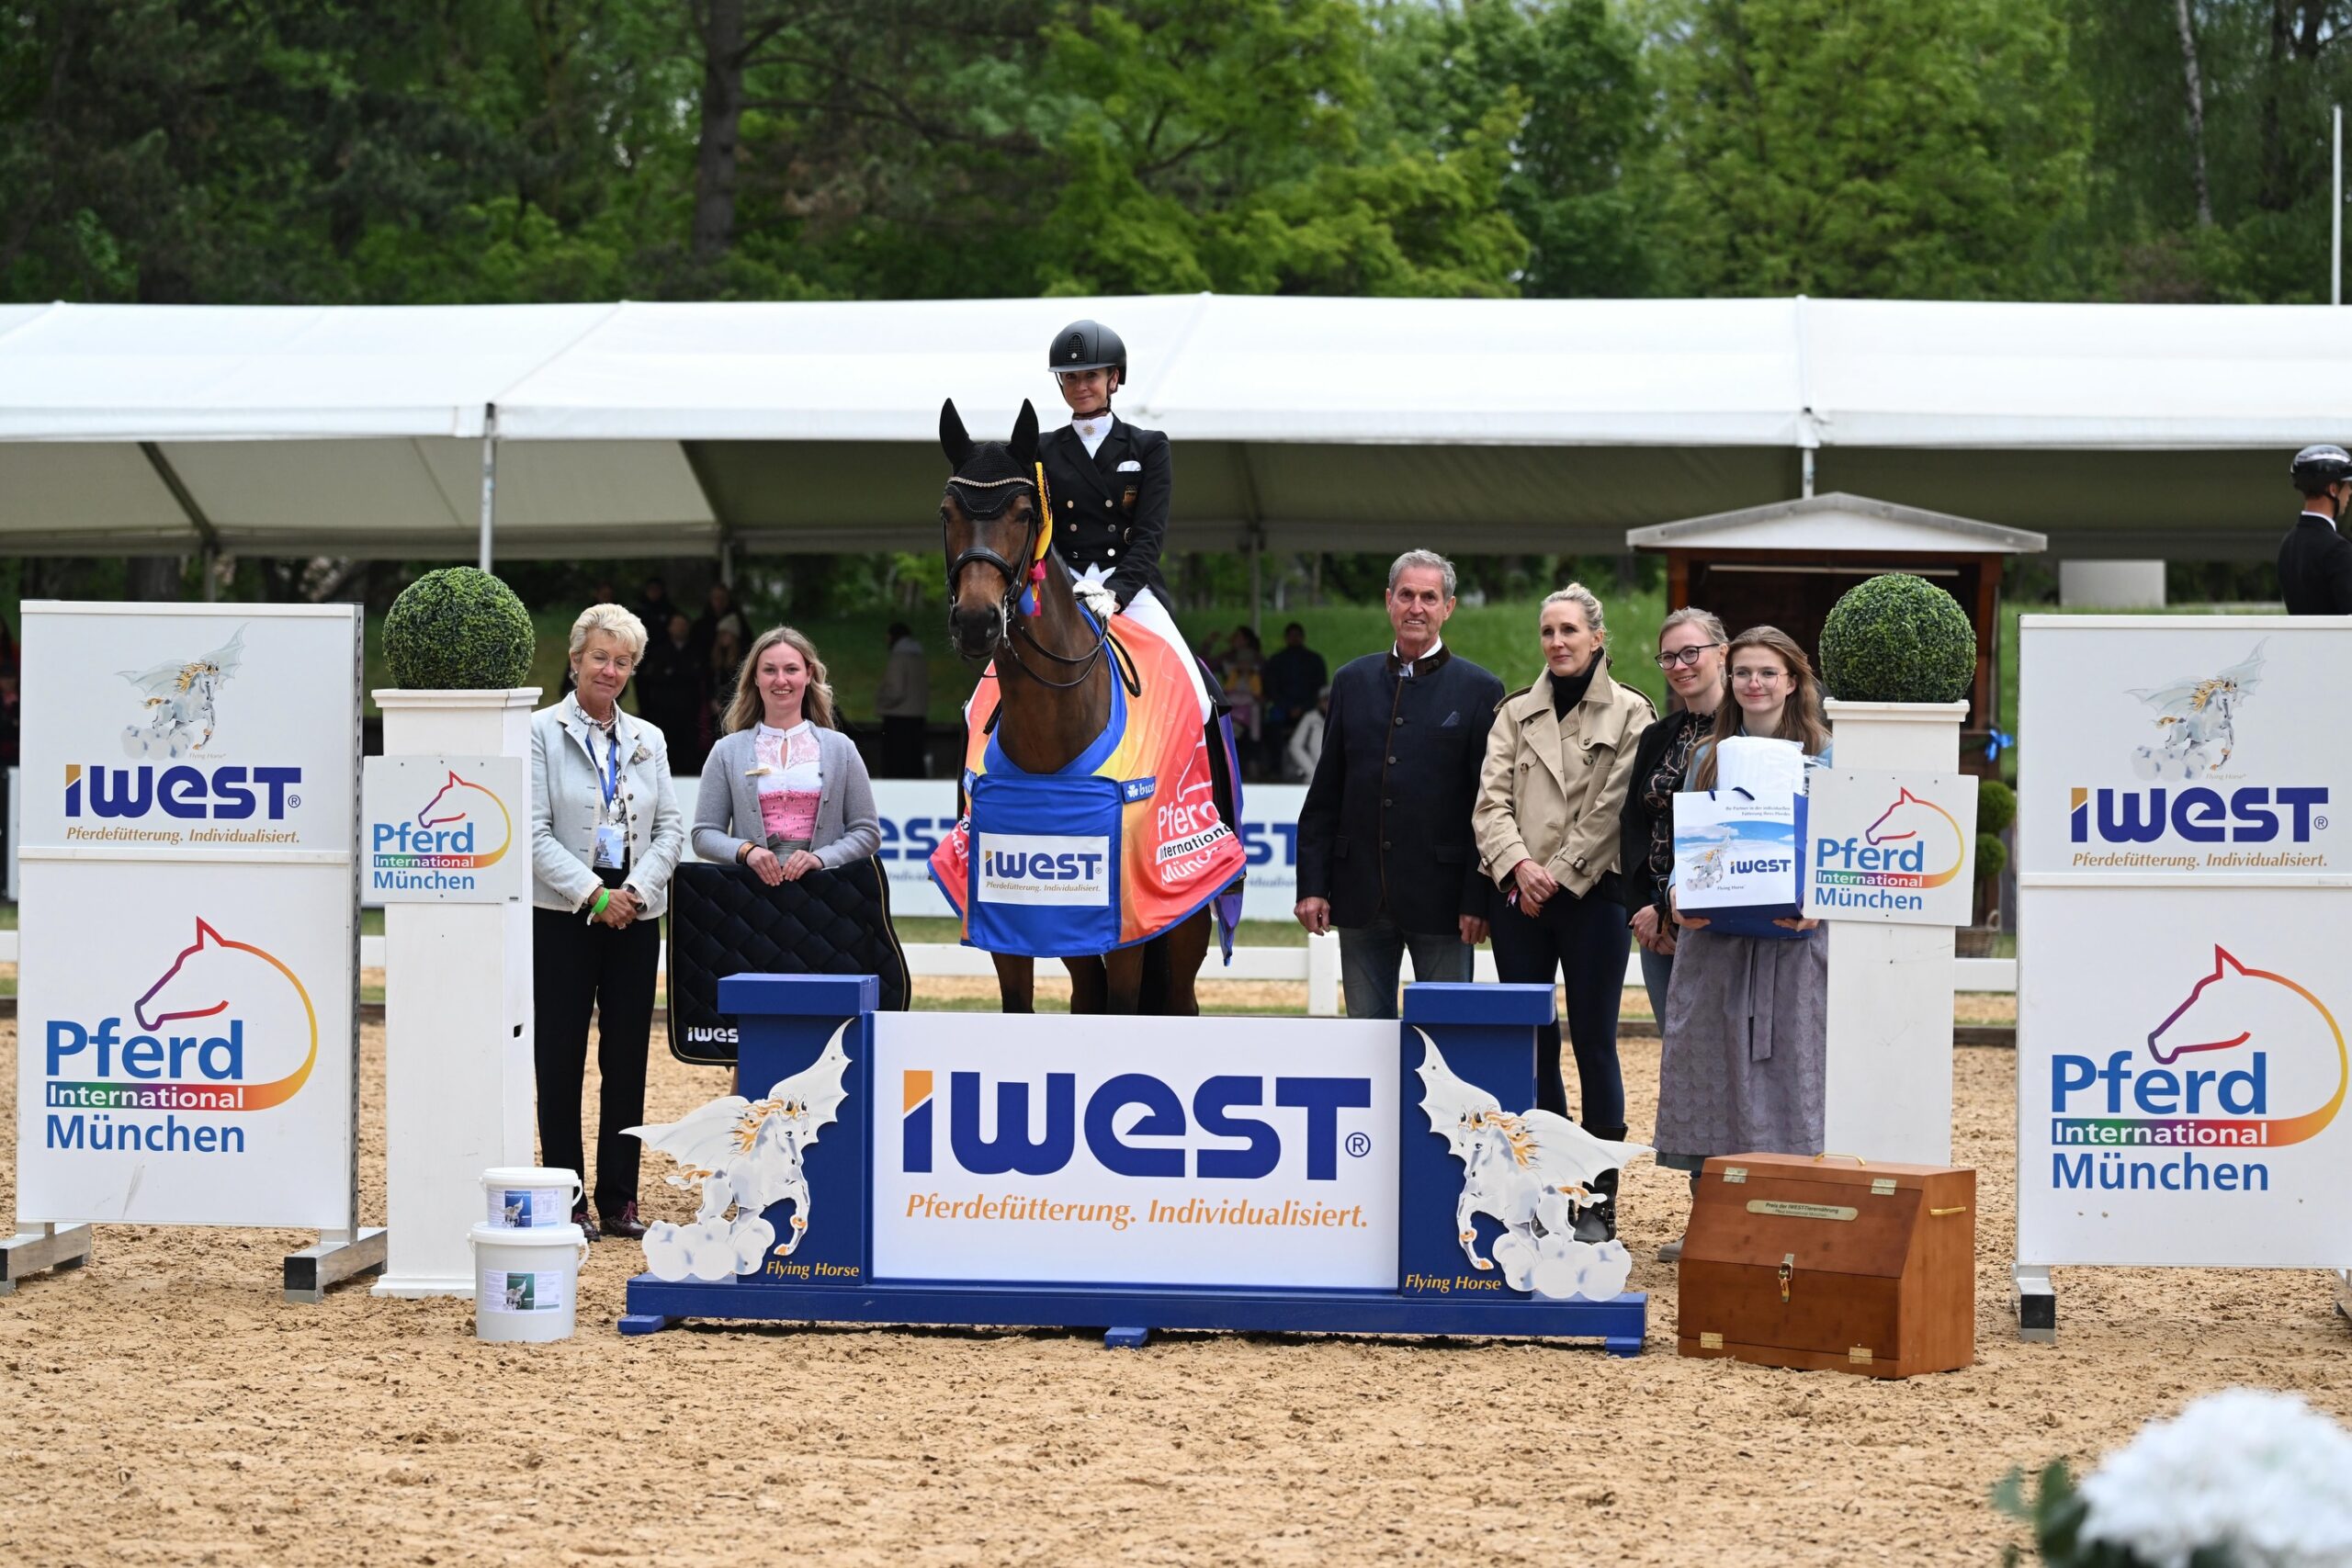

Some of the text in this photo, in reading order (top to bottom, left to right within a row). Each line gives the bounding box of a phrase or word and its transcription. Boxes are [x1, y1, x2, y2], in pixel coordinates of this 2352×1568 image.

[67, 826, 300, 846] Pferdefütterung. Individualisiert.
[374, 821, 474, 853] Pferd
[374, 855, 474, 868] International
[1816, 837, 1925, 873] Pferd
[2073, 852, 2328, 872] Pferdefütterung. Individualisiert.
[374, 870, 475, 890] München
[986, 881, 1102, 893] Pferdefütterung. Individualisiert.
[1817, 871, 1923, 887] International
[1815, 886, 1923, 910] München
[47, 1017, 243, 1080] Pferd
[2052, 1050, 2267, 1115] Pferd
[50, 1084, 243, 1109] International
[47, 1113, 244, 1153] München
[2055, 1122, 2268, 1145] International
[2052, 1151, 2269, 1191] München
[906, 1192, 1368, 1231] Pferdefütterung. Individualisiert.
[765, 1260, 860, 1280] Flying Horse
[1405, 1273, 1502, 1293] Flying Horse
